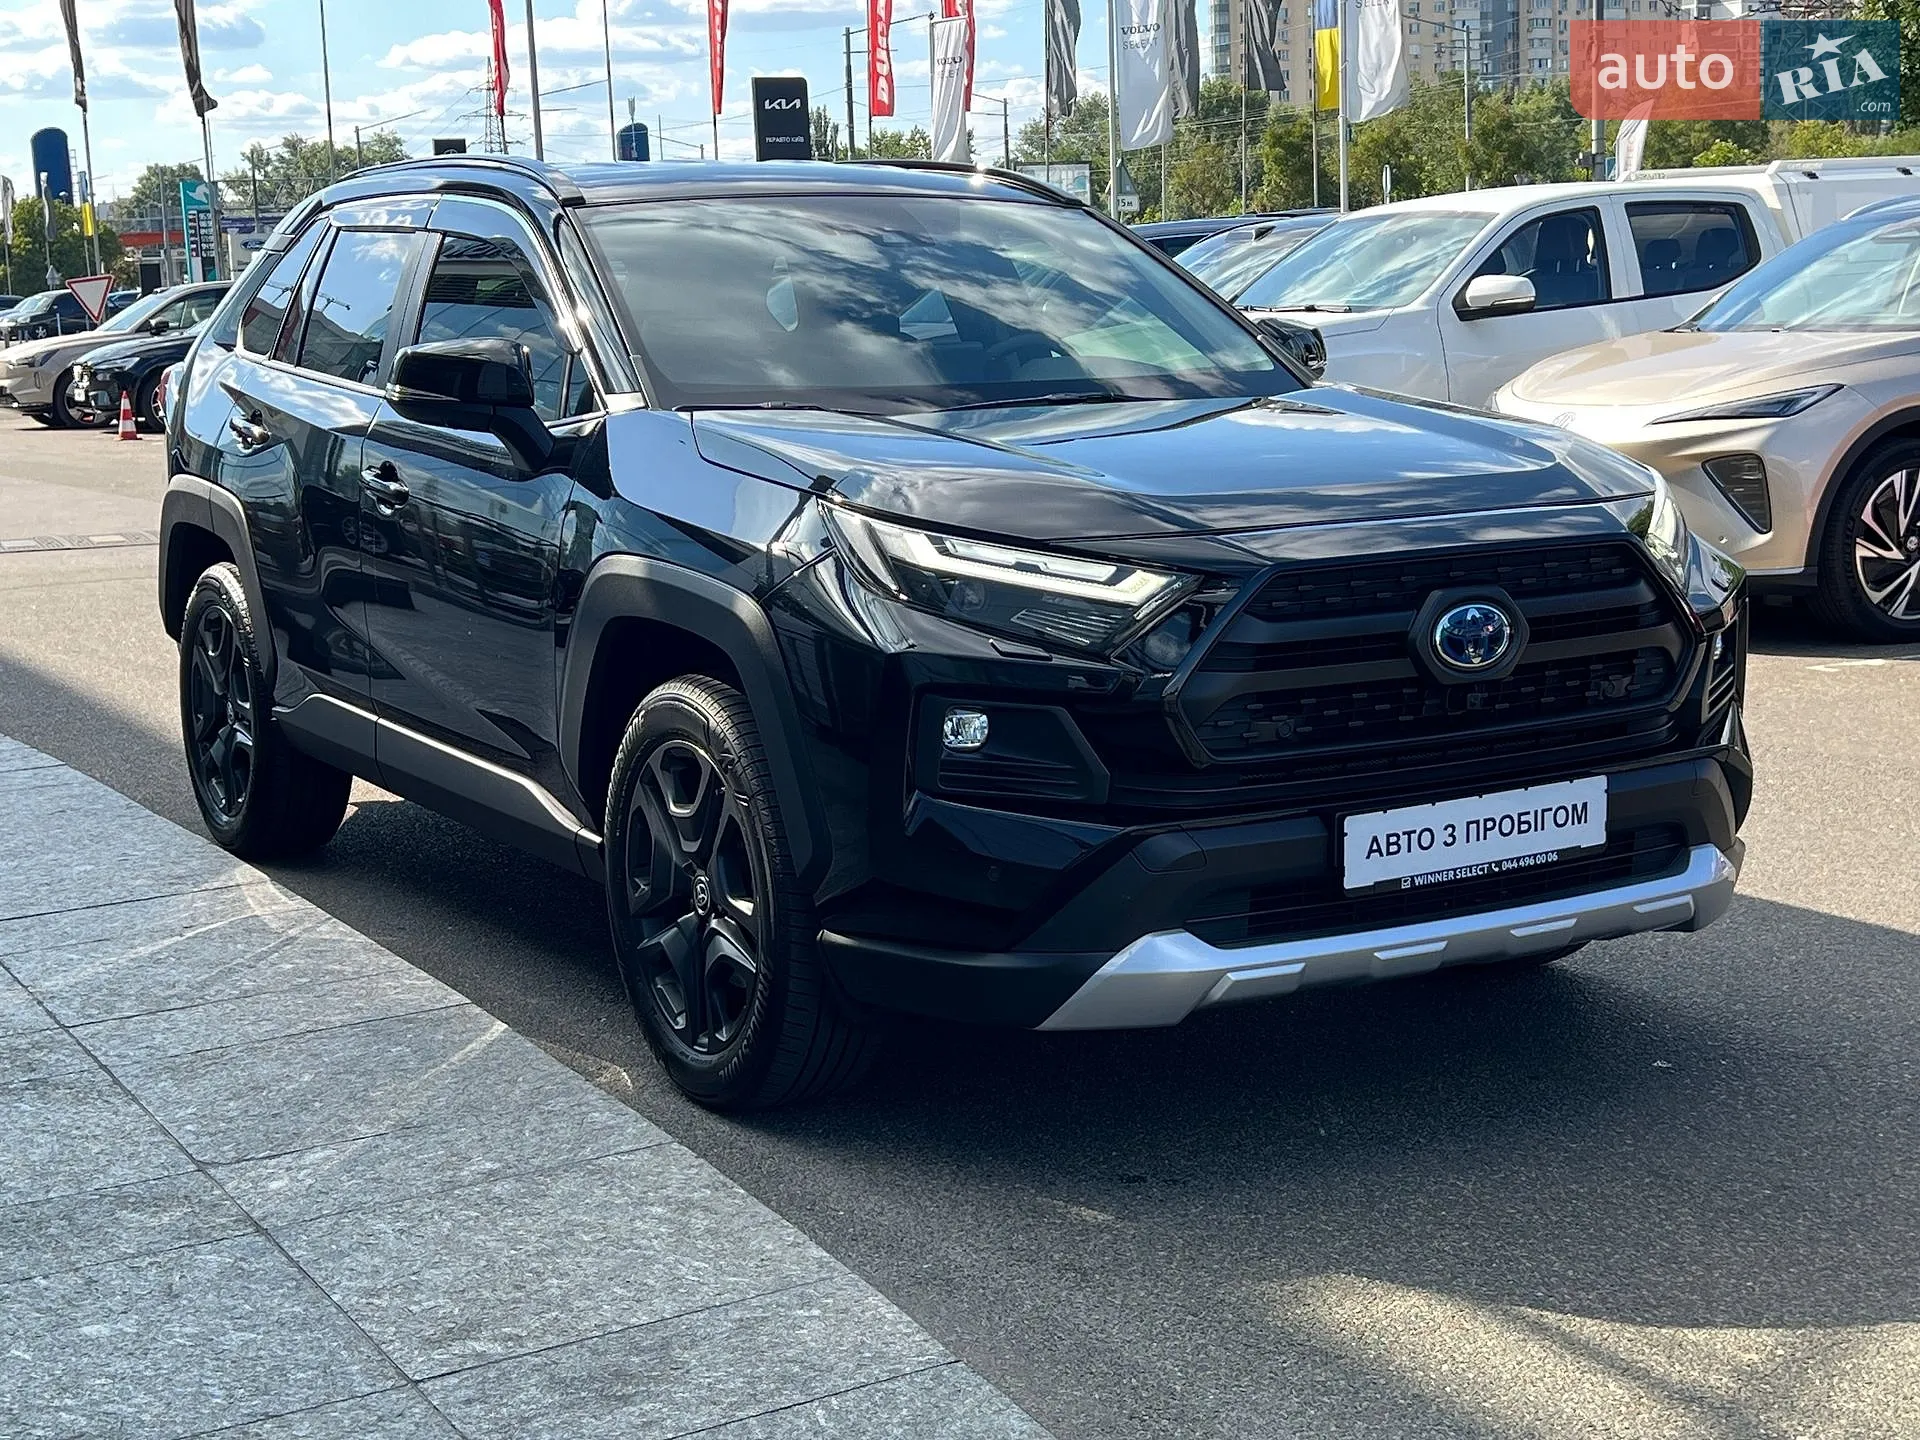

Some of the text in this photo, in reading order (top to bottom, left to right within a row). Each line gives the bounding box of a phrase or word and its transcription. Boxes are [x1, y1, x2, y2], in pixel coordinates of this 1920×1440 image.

[1121, 23, 1161, 36] VOLVO
[764, 98, 801, 110] KIA
[1365, 801, 1588, 860] АВТО З ПРОБІГОМ
[1413, 851, 1559, 886] WINNER SELECT 044 496 00 06
